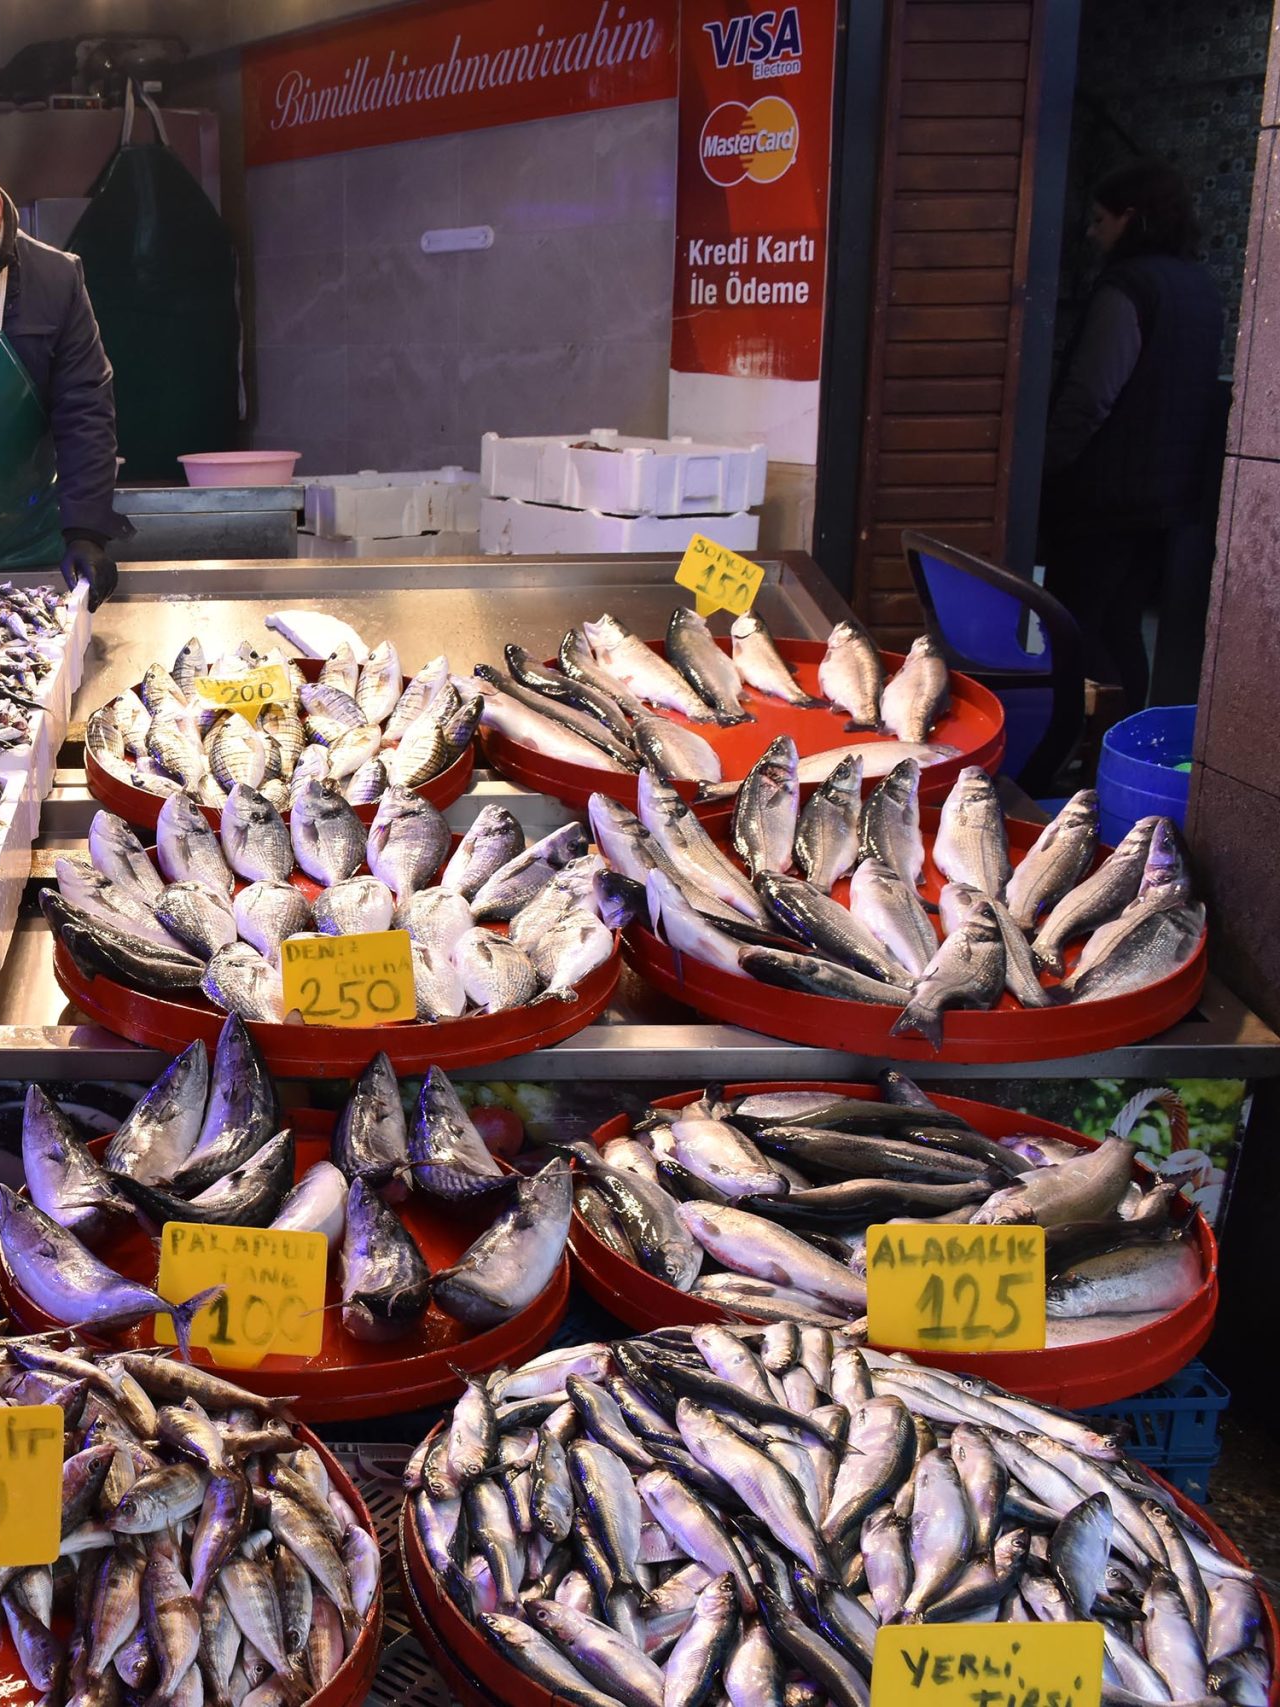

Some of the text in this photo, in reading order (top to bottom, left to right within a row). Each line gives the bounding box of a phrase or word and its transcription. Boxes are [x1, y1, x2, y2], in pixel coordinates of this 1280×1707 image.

[703, 7, 802, 68] VISA
[753, 61, 800, 79] Electron
[704, 127, 795, 157] MasterCard
[688, 235, 815, 266] Kredi Kartı
[690, 271, 810, 305] İle Ödeme
[220, 682, 274, 704] 200
[300, 977, 400, 1020] 250
[208, 1290, 309, 1346] 100
[915, 1272, 1034, 1340] 125
[900, 1641, 1020, 1688] YERLİ
